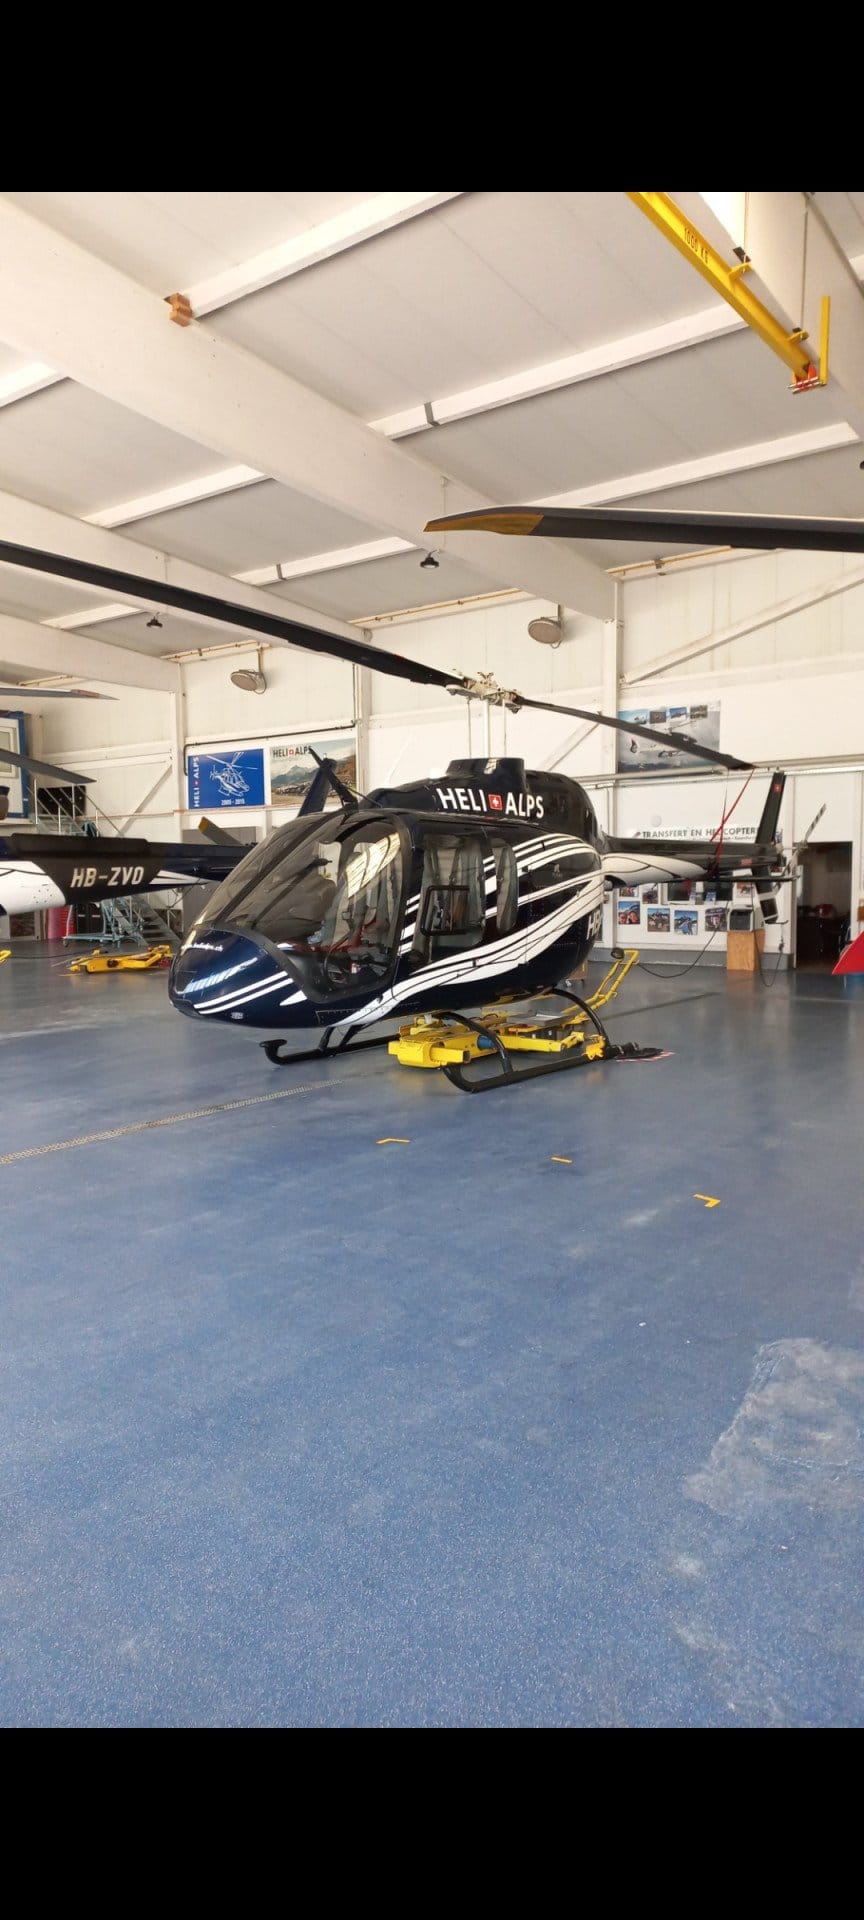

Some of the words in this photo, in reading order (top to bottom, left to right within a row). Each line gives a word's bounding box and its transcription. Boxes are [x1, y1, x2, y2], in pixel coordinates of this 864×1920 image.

[273, 748, 288, 758] HELI
[193, 787, 201, 807] HELI
[436, 788, 487, 812] HELI
[505, 792, 544, 818] ALPS
[642, 829, 688, 838] TRANSFERT
[691, 829, 702, 837] EN
